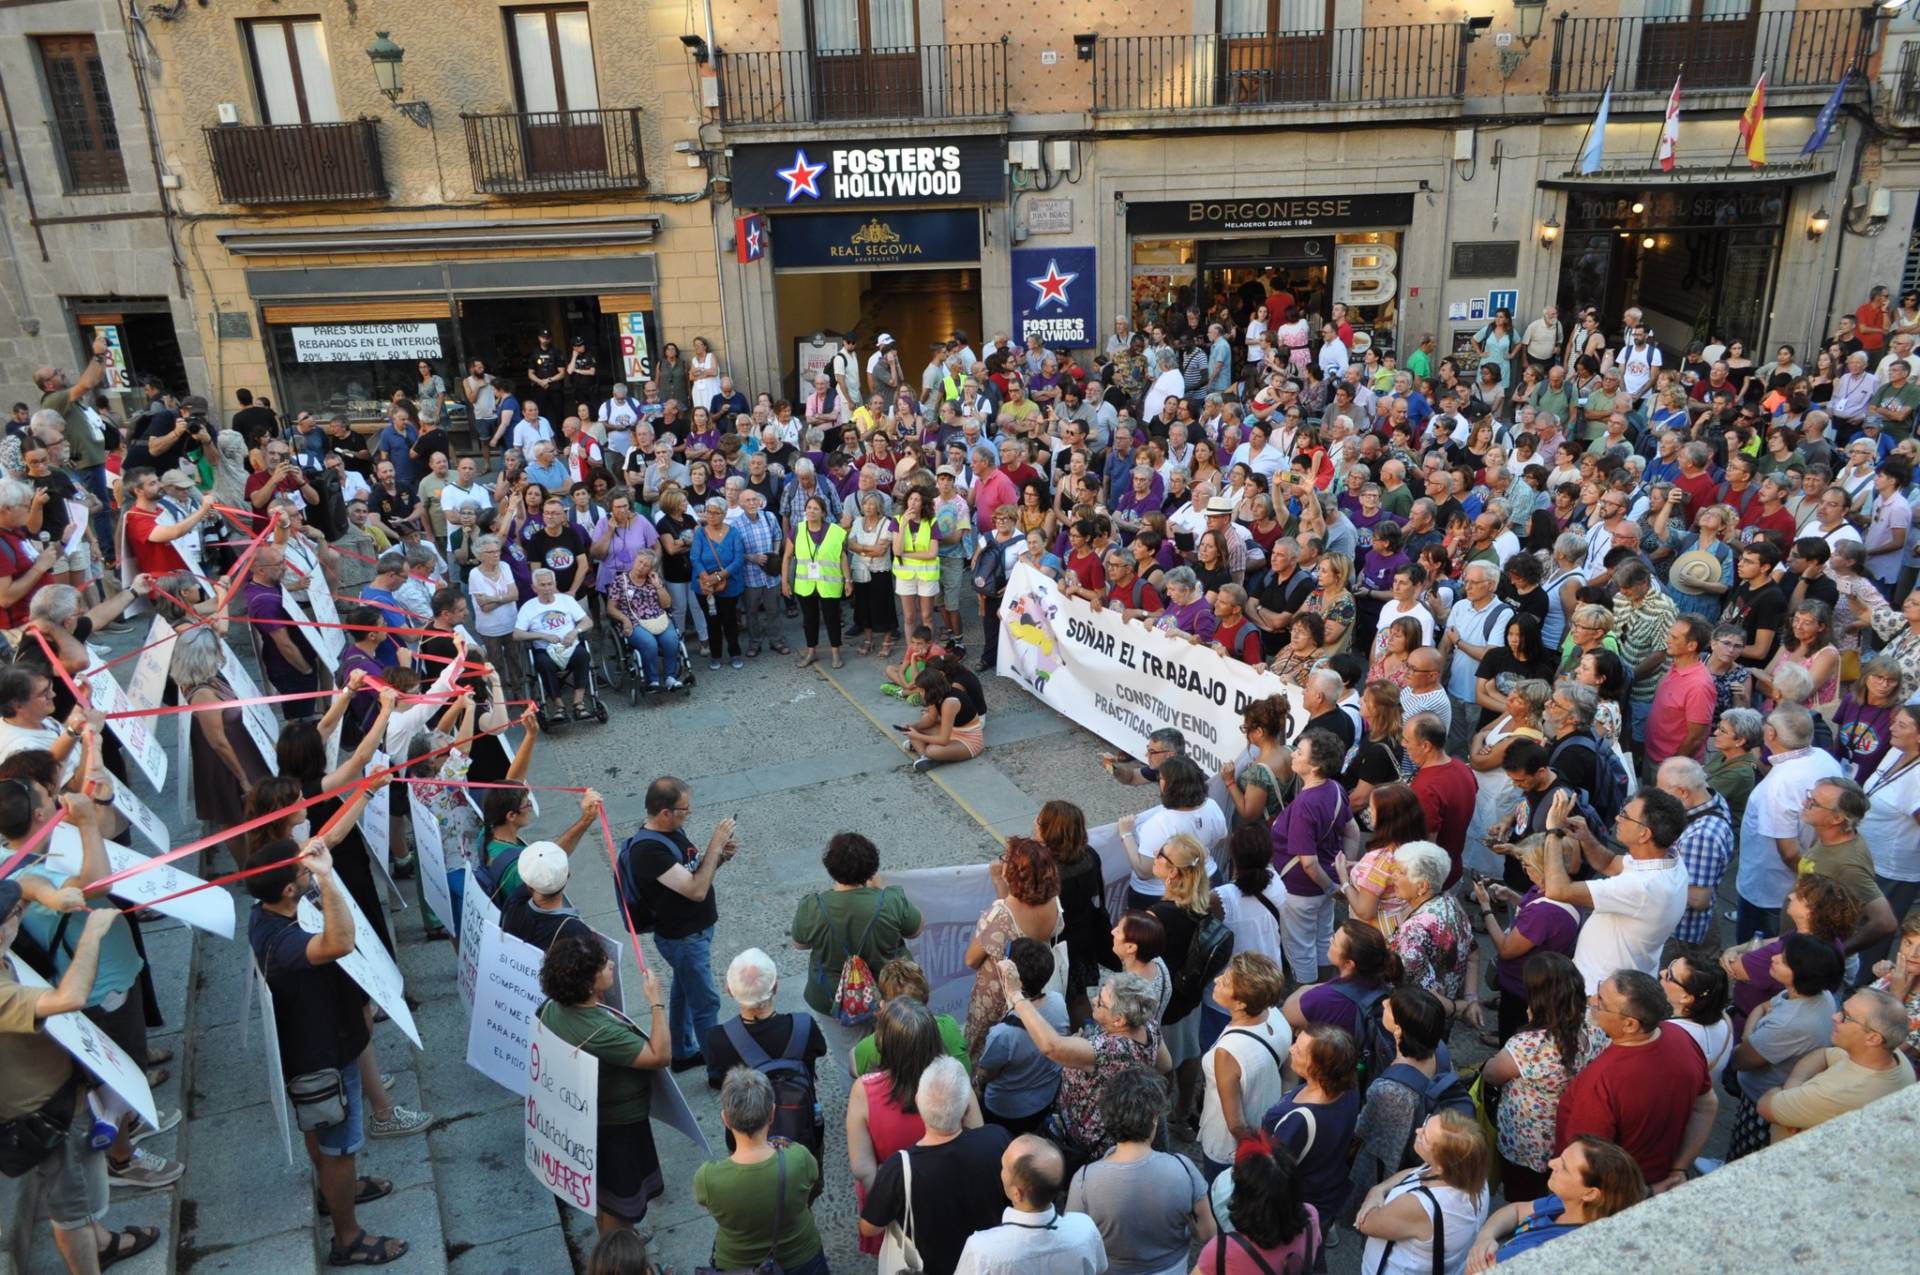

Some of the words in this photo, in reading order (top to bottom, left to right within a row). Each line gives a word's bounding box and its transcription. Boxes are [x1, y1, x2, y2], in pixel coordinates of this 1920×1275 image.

[832, 146, 960, 174] FOSTER'S
[833, 170, 961, 199] HOLLYWOOD
[1188, 200, 1351, 221] BORGONESSE
[1224, 221, 1266, 229] HELADEROS
[830, 246, 861, 257] REAL
[866, 244, 922, 256] SEGOVIA
[1334, 244, 1397, 305] B
[313, 325, 347, 335] PARES
[350, 324, 394, 335] SUELTOS
[396, 323, 420, 334] MUY
[1022, 318, 1084, 331] FOSTER'S
[299, 338, 358, 350] REBAJADOS
[360, 338, 374, 348] EN
[377, 338, 390, 347] EL
[391, 336, 441, 347] INTERIOR
[416, 349, 442, 360] DTO.
[1065, 617, 1116, 659] SOÑAR
[1119, 641, 1137, 669] EL
[1142, 650, 1227, 708] TRABAJO
[1095, 693, 1153, 741] PRÁCTICAS
[1116, 683, 1218, 745] CONSTRUYENDO
[494, 999, 508, 1013] NO
[509, 1007, 523, 1022] ME
[510, 1031, 529, 1050] PAG
[493, 1045, 504, 1060] EL
[529, 1042, 540, 1082] 9
[541, 1150, 593, 1209] MUJERES
